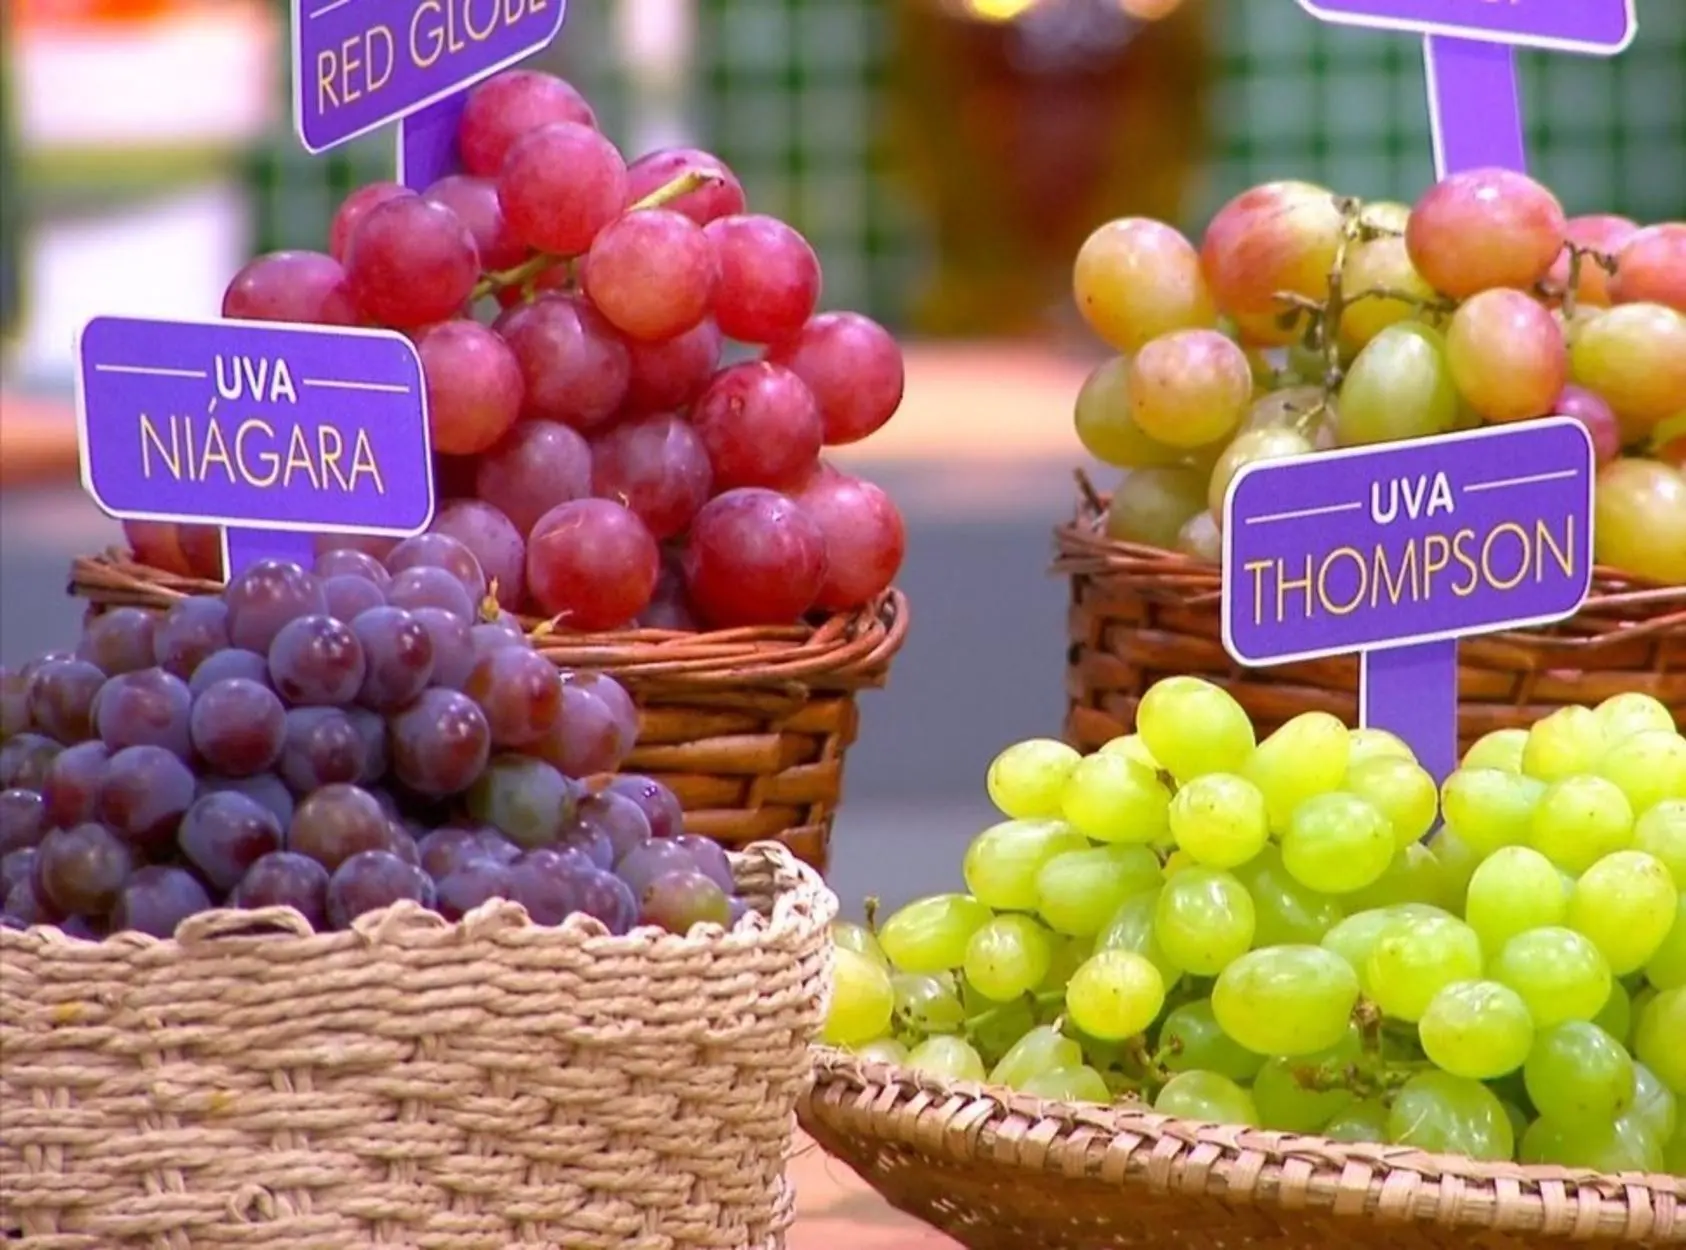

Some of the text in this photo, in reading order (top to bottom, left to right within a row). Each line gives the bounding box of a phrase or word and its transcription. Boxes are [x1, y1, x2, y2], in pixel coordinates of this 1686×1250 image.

[317, 0, 548, 114] RED GLO
[215, 354, 297, 404] UVA
[139, 397, 384, 494] NIÁGARA
[1371, 471, 1455, 525] UVA
[1243, 514, 1575, 626] THOMPSON
